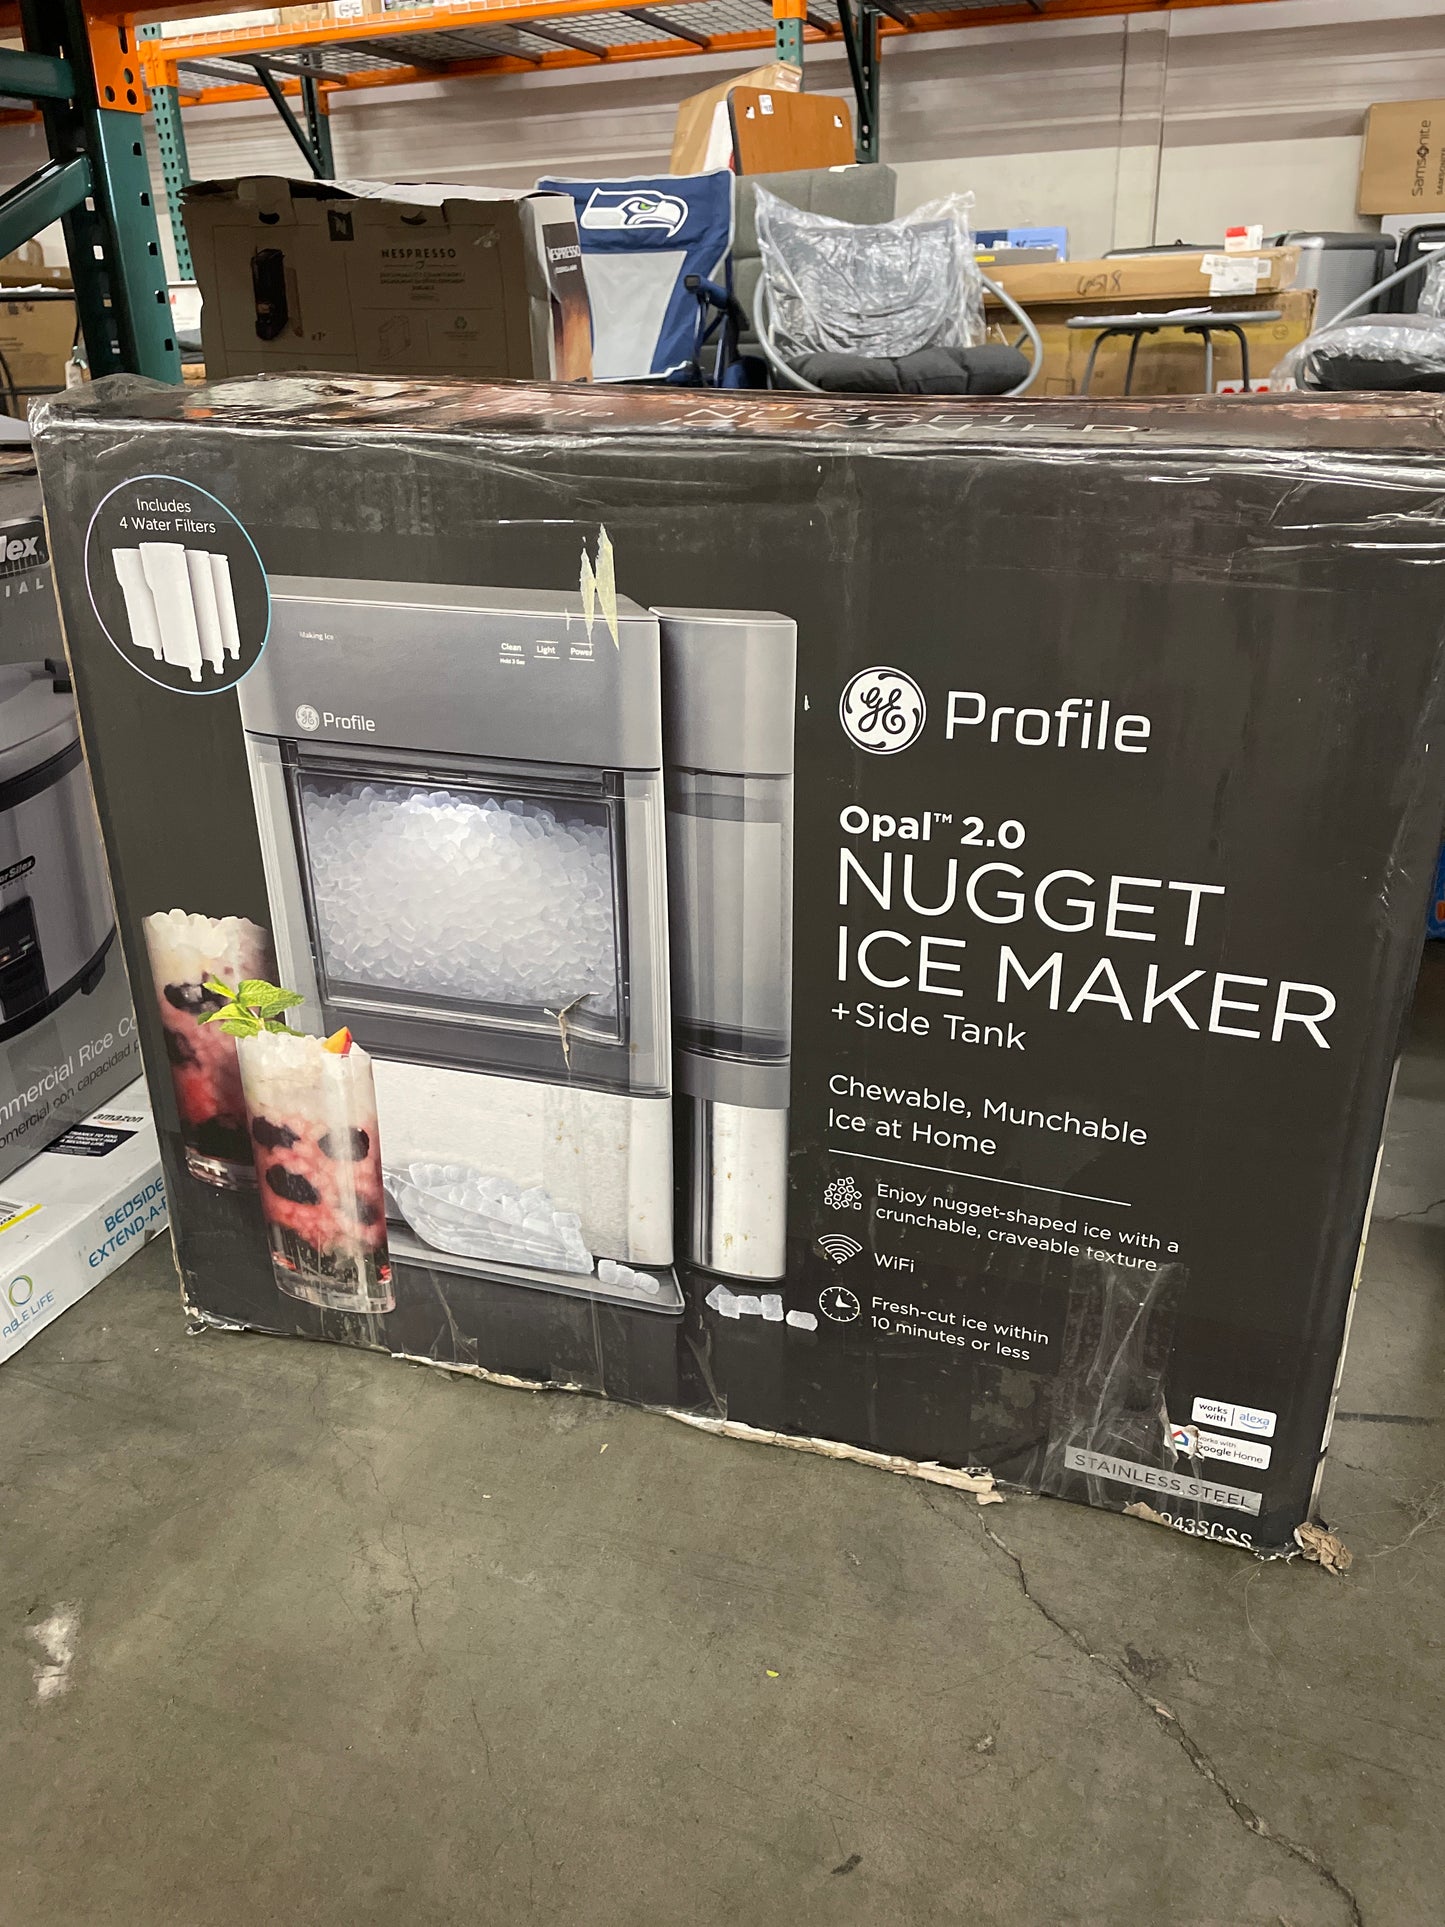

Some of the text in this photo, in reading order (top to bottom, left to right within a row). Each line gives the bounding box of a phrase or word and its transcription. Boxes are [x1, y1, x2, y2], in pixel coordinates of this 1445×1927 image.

[381, 247, 457, 259] NESPRESSO
[546, 245, 581, 263] NESPRESSO
[684, 408, 1036, 423] NUGGET
[136, 498, 192, 513] Includes
[119, 516, 216, 534] 4 Water Filters
[299, 631, 323, 641] Making
[501, 643, 522, 652] Clean
[536, 645, 556, 655] Light
[570, 647, 592, 656] Power
[322, 712, 376, 732] Profile
[945, 690, 1151, 753] Profile
[960, 816, 1026, 850] 2.0
[838, 847, 1226, 946] NUGGET
[838, 925, 1337, 1050] ICE MAKER
[943, 1014, 1027, 1051] Tank
[78, 1032, 114, 1068] Rice
[53, 1087, 75, 1110] con
[77, 1043, 131, 1092] capacidad
[93, 1113, 144, 1123] amazon
[828, 1074, 1149, 1147] Chewable, Munchable
[829, 1107, 998, 1156] Ice at Home
[104, 1176, 164, 1232] BEDSIDE
[877, 1183, 1180, 1254] Enjoy nugget-shaped ice with a
[875, 1206, 1158, 1272] crunchable, craveable texture
[874, 1252, 915, 1273] WiFi
[2, 1309, 30, 1339] ABLE
[30, 1290, 55, 1315] LIFE
[871, 1296, 1049, 1345] Fresh-cut ice within
[870, 1315, 1031, 1361] 10 minutes or less
[1199, 1402, 1228, 1415] works
[1205, 1412, 1227, 1423] with
[1239, 1412, 1270, 1426] alexa
[1219, 1439, 1237, 1449] with
[1233, 1450, 1264, 1464] Home
[1074, 1453, 1250, 1508] STAINLESS STEEL
